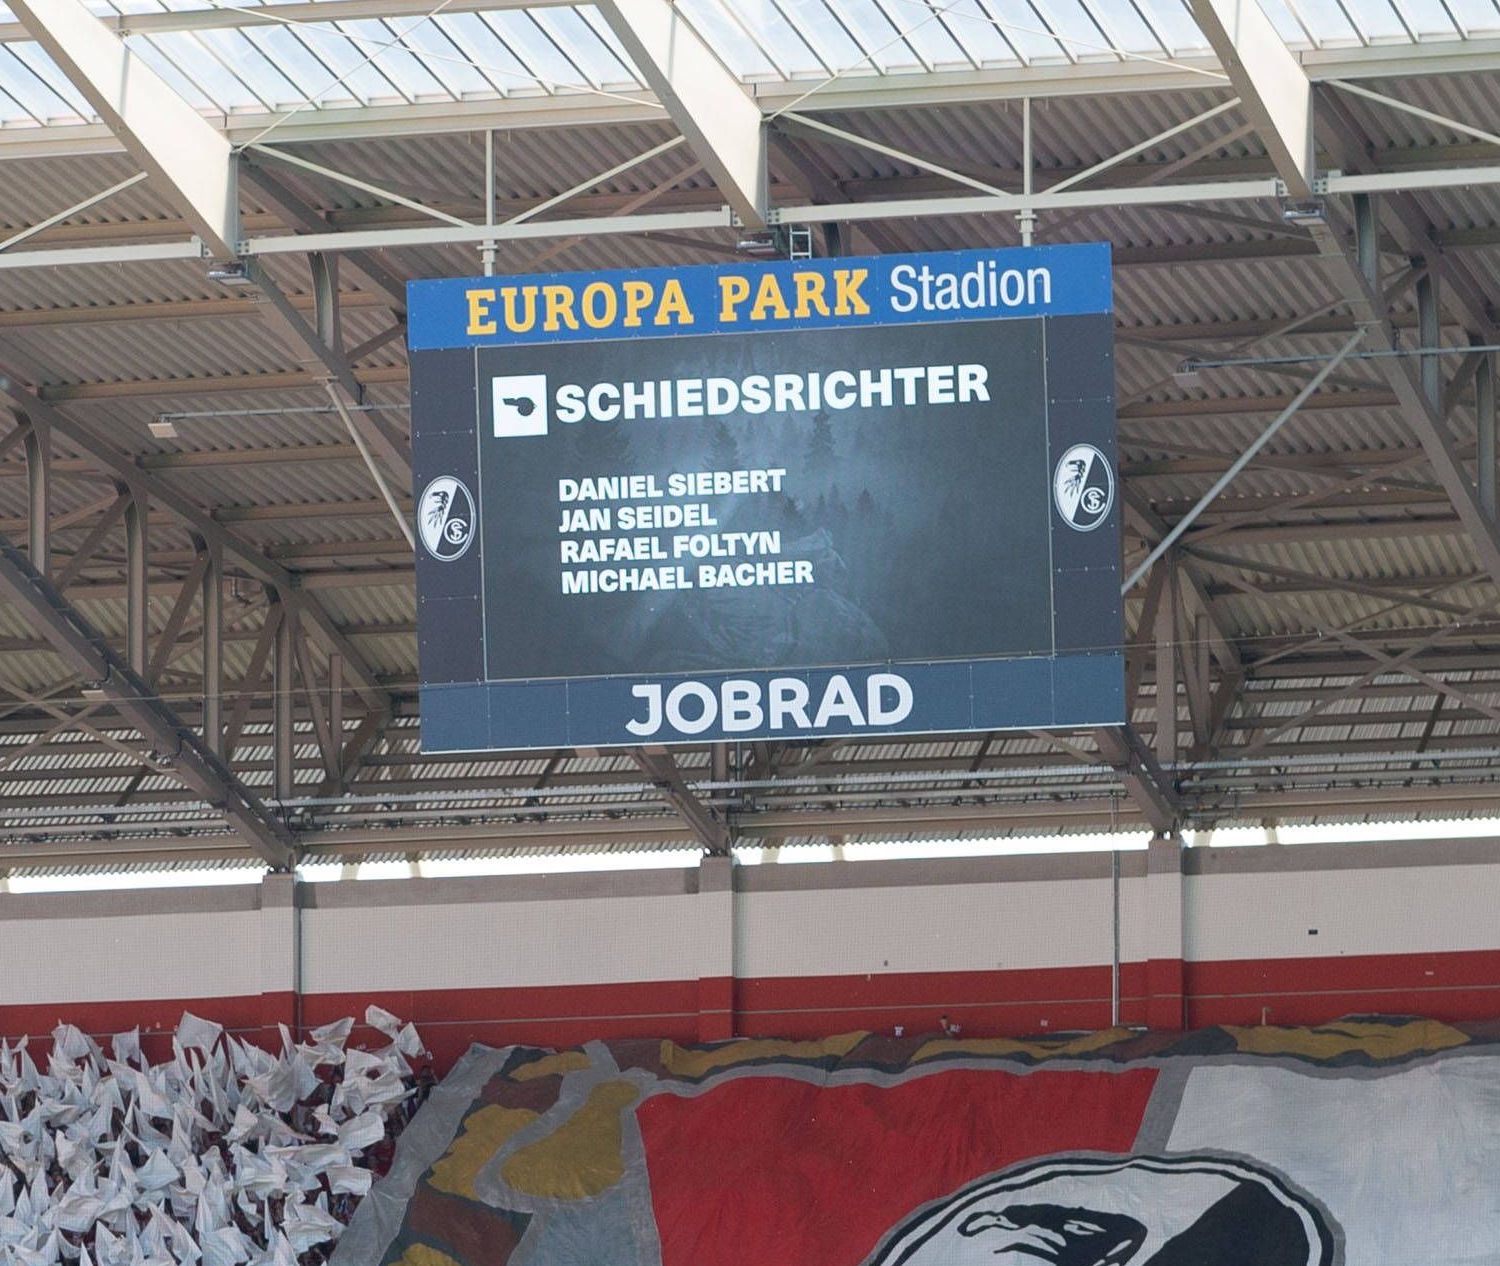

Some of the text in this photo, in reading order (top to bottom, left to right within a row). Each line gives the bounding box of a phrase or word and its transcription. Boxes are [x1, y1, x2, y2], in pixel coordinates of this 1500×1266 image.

[465, 259, 1053, 336] EUROPA PARK Stadion
[555, 363, 991, 423] SCHIEDSRICHTER
[558, 467, 786, 502] DANIEL SIEBERT
[558, 501, 717, 533] JAN SEIDEL
[560, 532, 781, 565] RAFAEL FOLTYN
[561, 560, 814, 595] MICHAEL BACHER
[626, 673, 914, 737] JOBRAD
